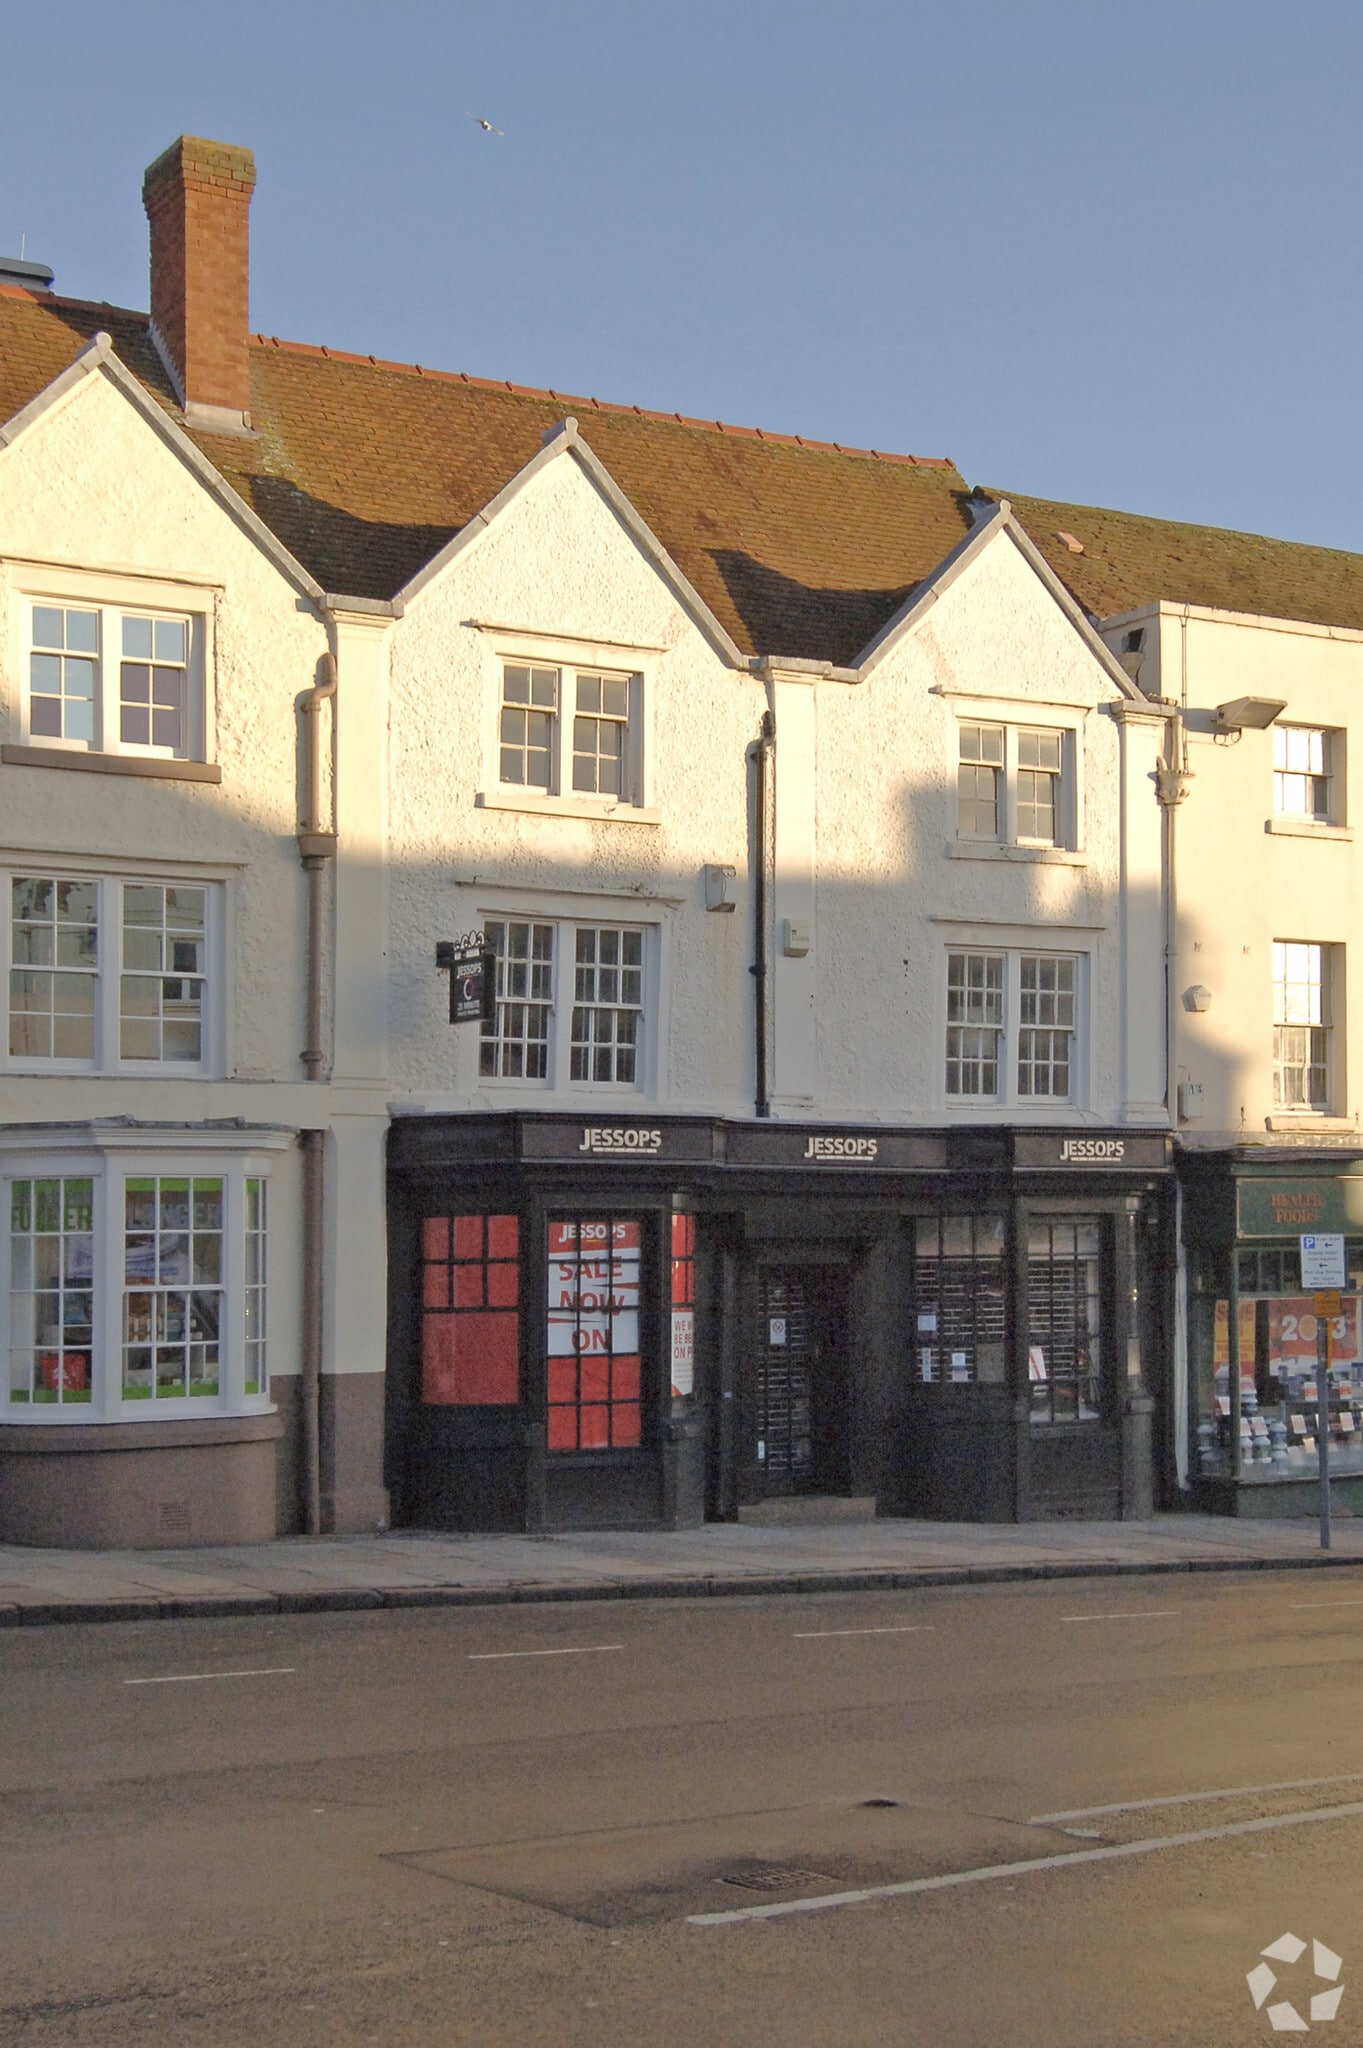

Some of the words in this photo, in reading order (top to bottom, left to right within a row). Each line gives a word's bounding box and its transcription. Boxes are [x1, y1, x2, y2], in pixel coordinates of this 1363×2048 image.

[456, 962, 482, 979] JESSOPS
[579, 1128, 662, 1152] JESSOPS
[804, 1137, 878, 1160] JESSOPS
[1060, 1140, 1125, 1162] JESSOPS
[559, 1225, 626, 1243] JESSOPS
[559, 1256, 623, 1281] SALE
[560, 1290, 625, 1316] NOW
[674, 1319, 686, 1331] WE
[1281, 1314, 1347, 1341] 203
[572, 1328, 610, 1351] ON
[674, 1333, 683, 1344] BE
[674, 1347, 686, 1359] ON
